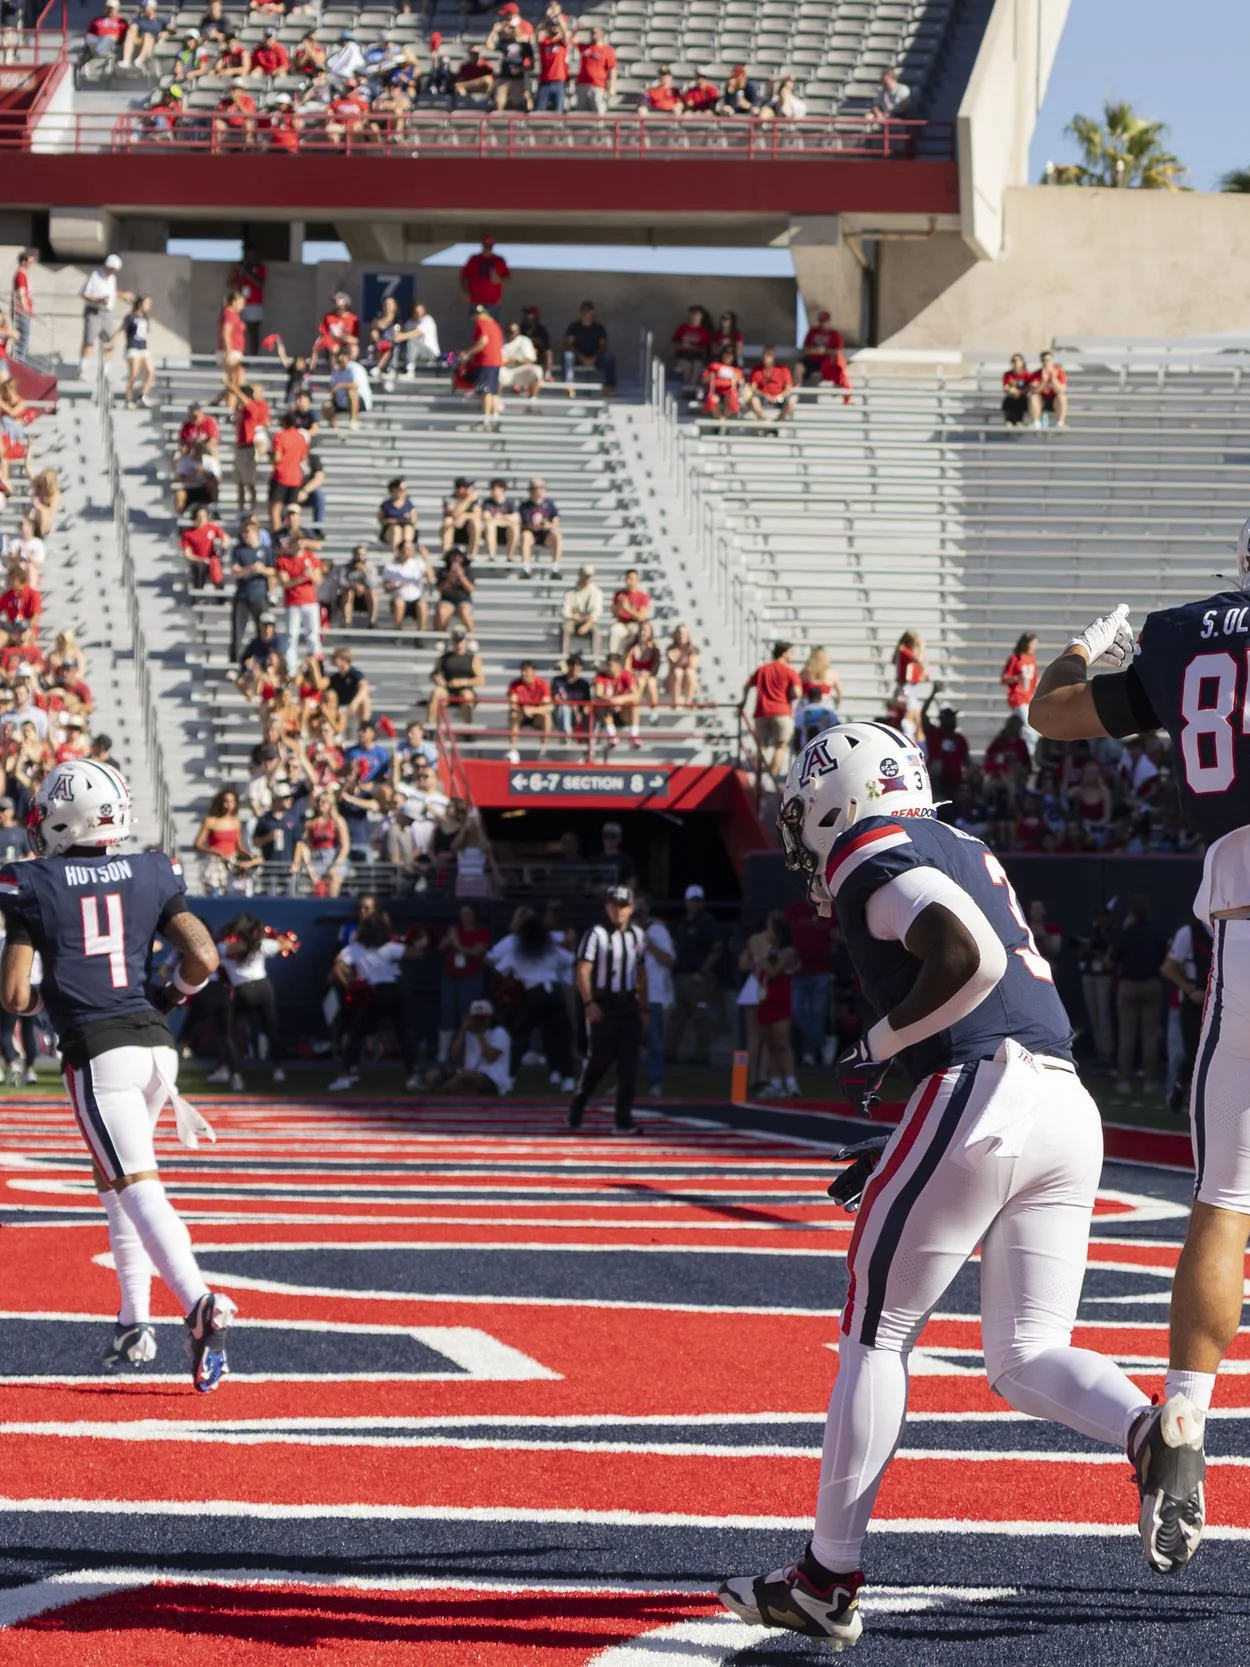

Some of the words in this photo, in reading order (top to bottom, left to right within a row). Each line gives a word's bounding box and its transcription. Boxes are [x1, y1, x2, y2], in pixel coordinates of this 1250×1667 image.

[529, 773, 560, 791] 6-7
[562, 775, 624, 790] SECTION
[630, 774, 645, 793] 8
[914, 771, 923, 790] 3
[64, 860, 132, 887] HUTSON
[80, 893, 128, 988] 4
